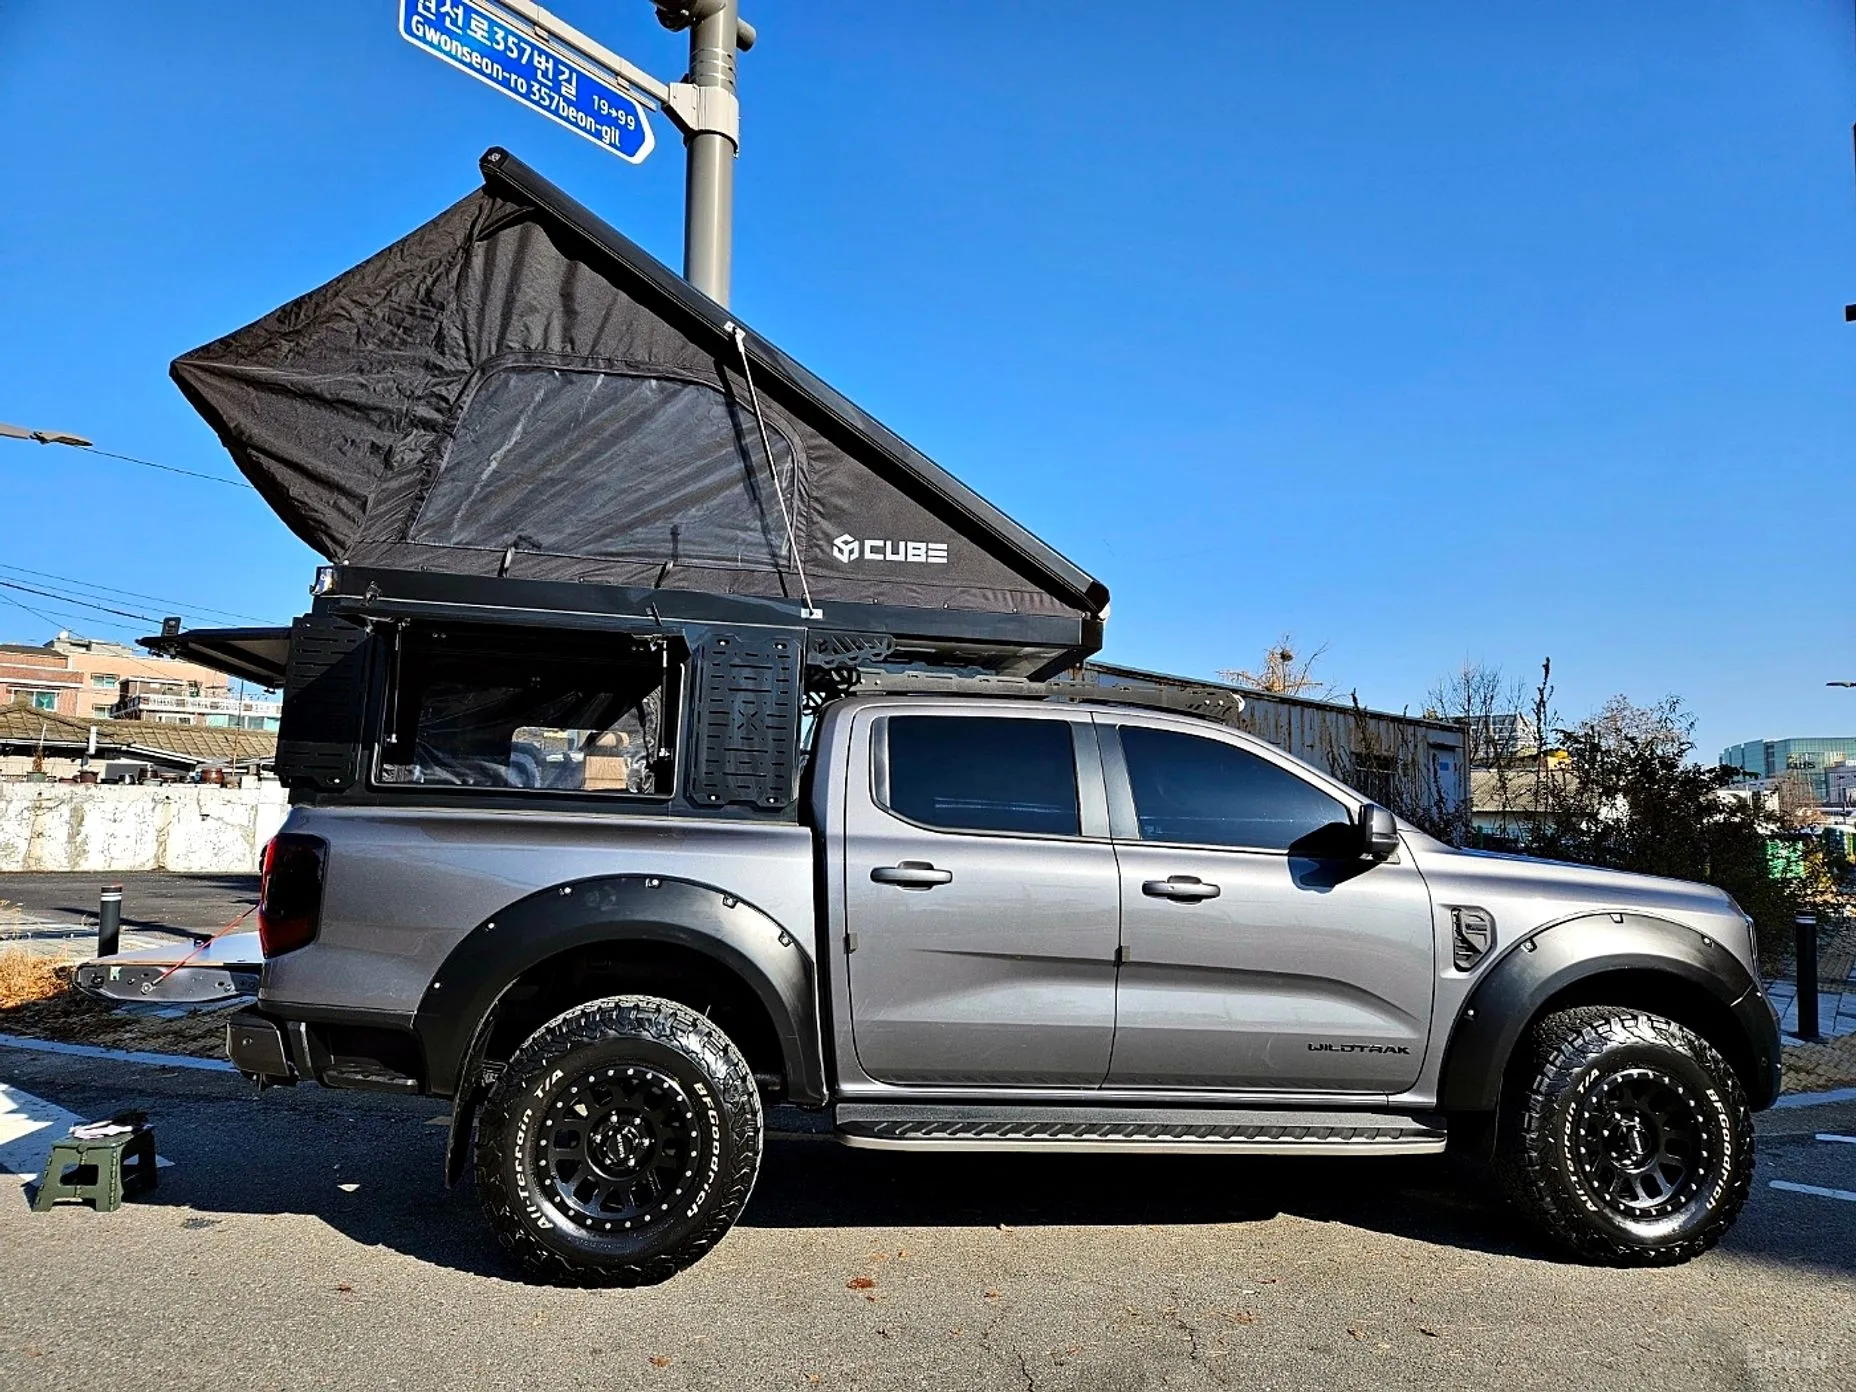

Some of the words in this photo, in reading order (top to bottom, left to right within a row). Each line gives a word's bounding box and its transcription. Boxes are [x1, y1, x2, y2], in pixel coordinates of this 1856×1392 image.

[411, 14, 527, 93] Gwonseon-ro
[530, 81, 621, 147] 357beon-gil
[864, 539, 948, 563] CUBE
[1308, 1043, 1410, 1055] WILDTRAK
